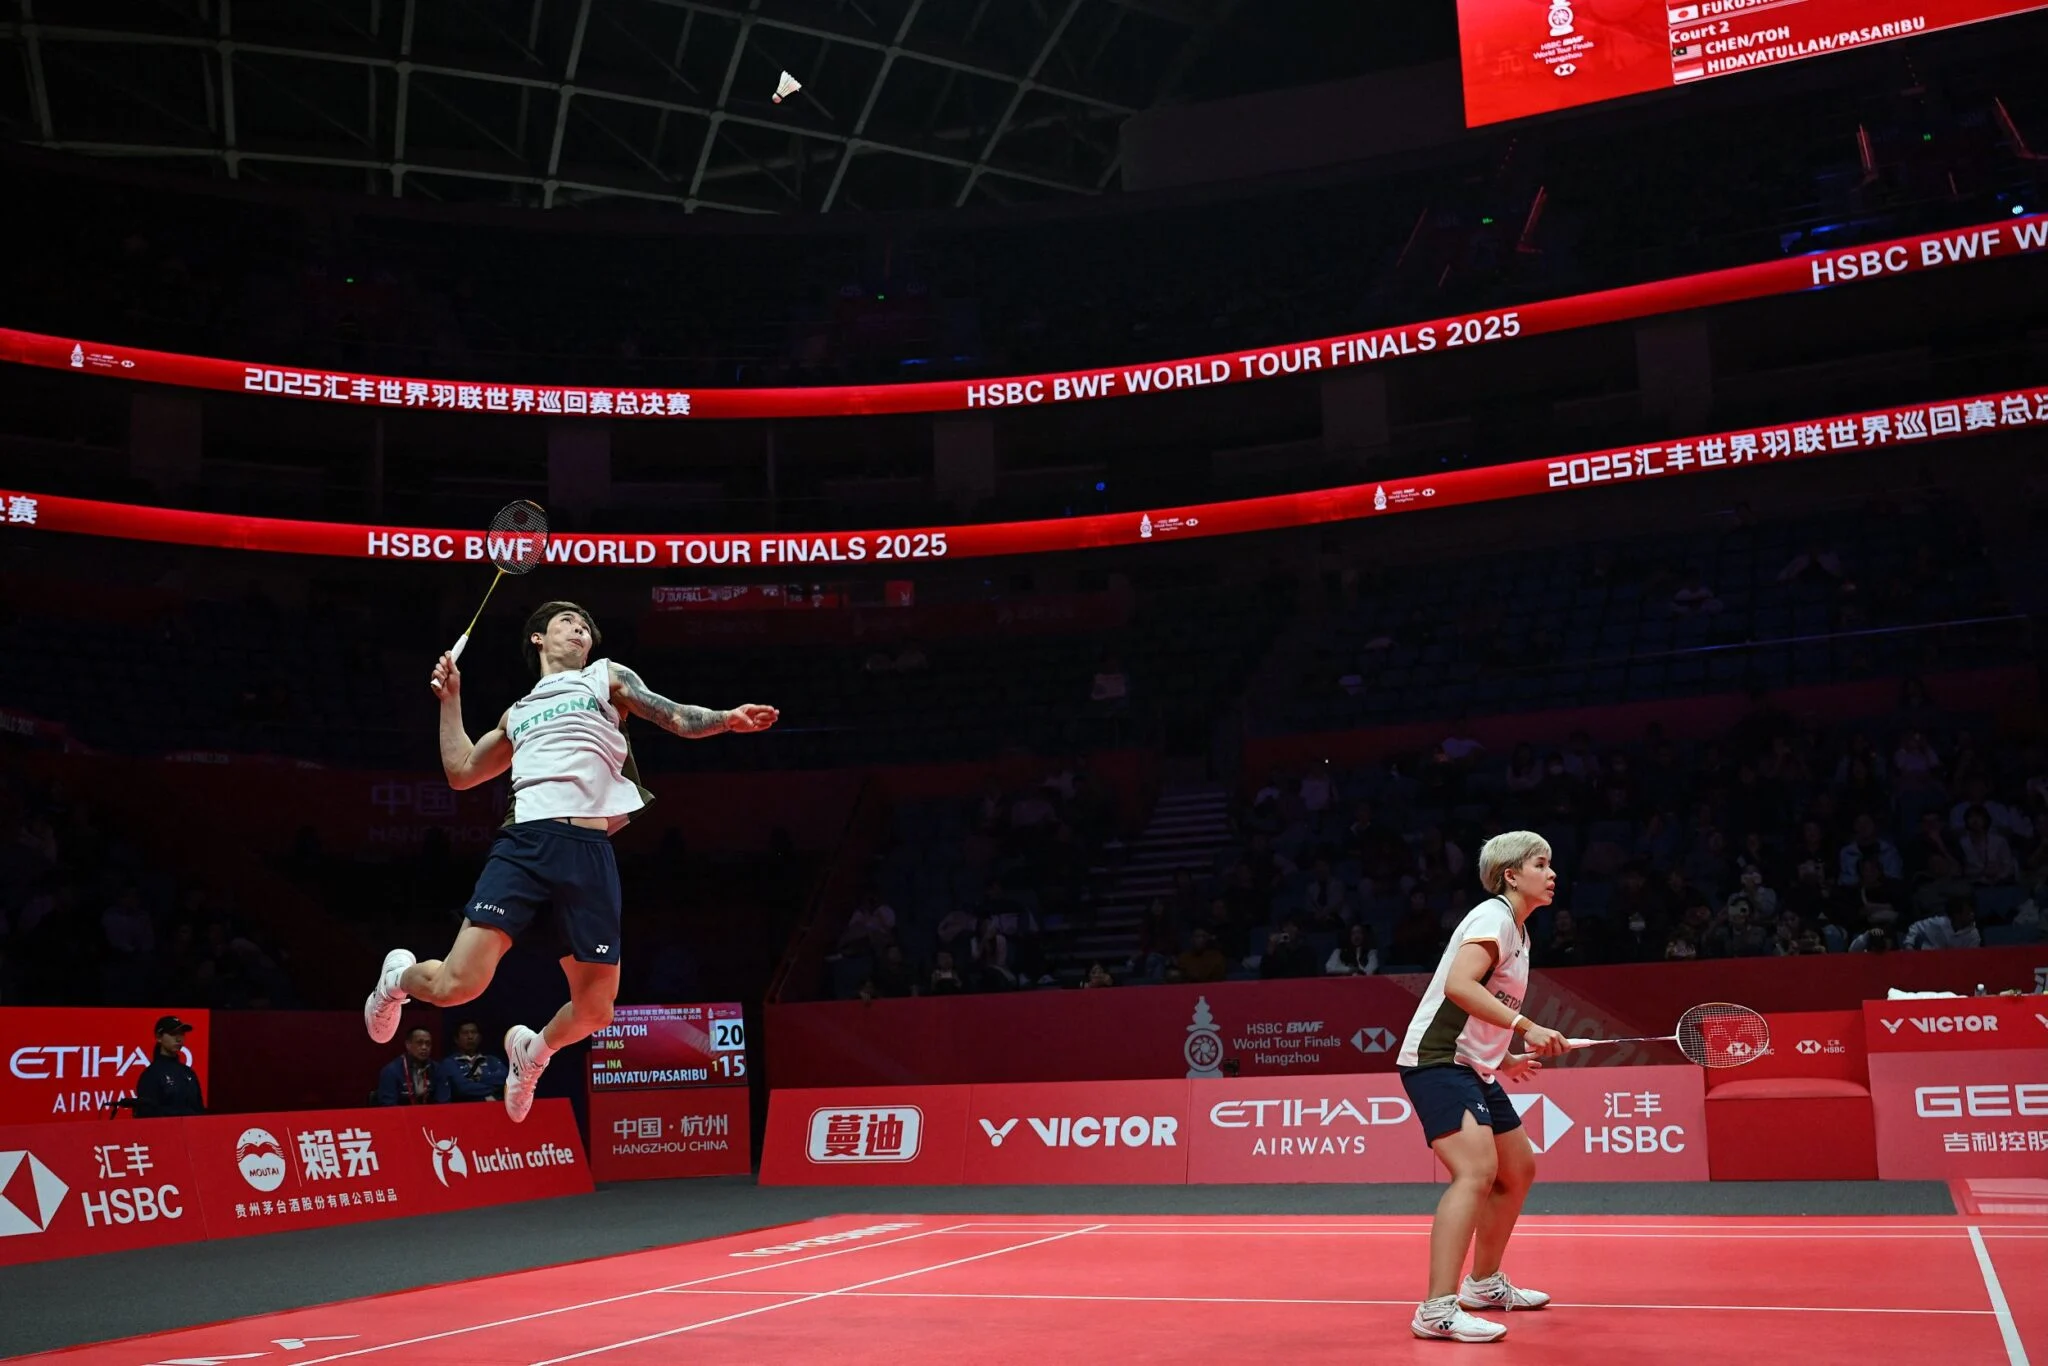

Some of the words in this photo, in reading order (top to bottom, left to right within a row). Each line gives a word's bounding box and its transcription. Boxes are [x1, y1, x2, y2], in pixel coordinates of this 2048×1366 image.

[1671, 24, 1717, 44] Court
[1720, 20, 1730, 33] 2
[1705, 26, 1790, 55] CHEN/TOH
[1707, 16, 1926, 74] HIDAYATULLAH/PASARIBU
[1811, 245, 1908, 285] HSBC
[1920, 228, 2001, 267] BWF
[967, 381, 1045, 407] HSBC
[1052, 374, 1116, 401] BWF
[1124, 360, 1231, 394] WORLD
[1239, 345, 1322, 379] TOUR
[1331, 327, 1437, 367] FINALS
[1446, 312, 1521, 348] 2025
[244, 367, 691, 416] 2025汇丰世界羽联世界巡回赛总决赛
[0, 496, 37, 524] 赛
[367, 531, 454, 560] HSBC
[464, 536, 534, 562] BWF
[543, 538, 656, 565] WORLD
[666, 538, 751, 565] TOUR
[761, 536, 866, 563] FINALS
[875, 532, 947, 559] 2025
[483, 904, 505, 916] AFFIN
[717, 1024, 743, 1046] 20
[1247, 1022, 1283, 1034] HSBC
[1286, 1021, 1324, 1033] BWF
[1909, 1015, 1998, 1033] VICTOR
[606, 1040, 625, 1049] MAS
[1233, 1038, 1271, 1050] World
[1273, 1036, 1302, 1048] Tour
[1304, 1036, 1341, 1047] Finals
[607, 1060, 622, 1069] INA
[719, 1055, 745, 1077] 15
[1254, 1051, 1320, 1066] Hangzhou
[593, 1068, 708, 1085] HIDAYATU/PASARIBU
[1209, 1097, 1412, 1128] ETIHAD
[1604, 1091, 1662, 1118] 汇丰
[824, 1112, 903, 1157] 蔓迪
[1026, 1115, 1178, 1148] VICTOR
[1252, 1135, 1366, 1155] AIRWAYS
[1584, 1125, 1685, 1153] HSBC
[94, 1142, 153, 1179] 汇丰
[472, 1147, 524, 1173] luckin
[526, 1143, 574, 1168] coffee
[612, 1141, 687, 1155] HANGZHOU
[689, 1139, 728, 1151] CHINA
[250, 1167, 280, 1177] MOUTAI
[81, 1184, 183, 1227] HSBC
[235, 1188, 398, 1219] 贵州茅台酒股份有限公司出品
